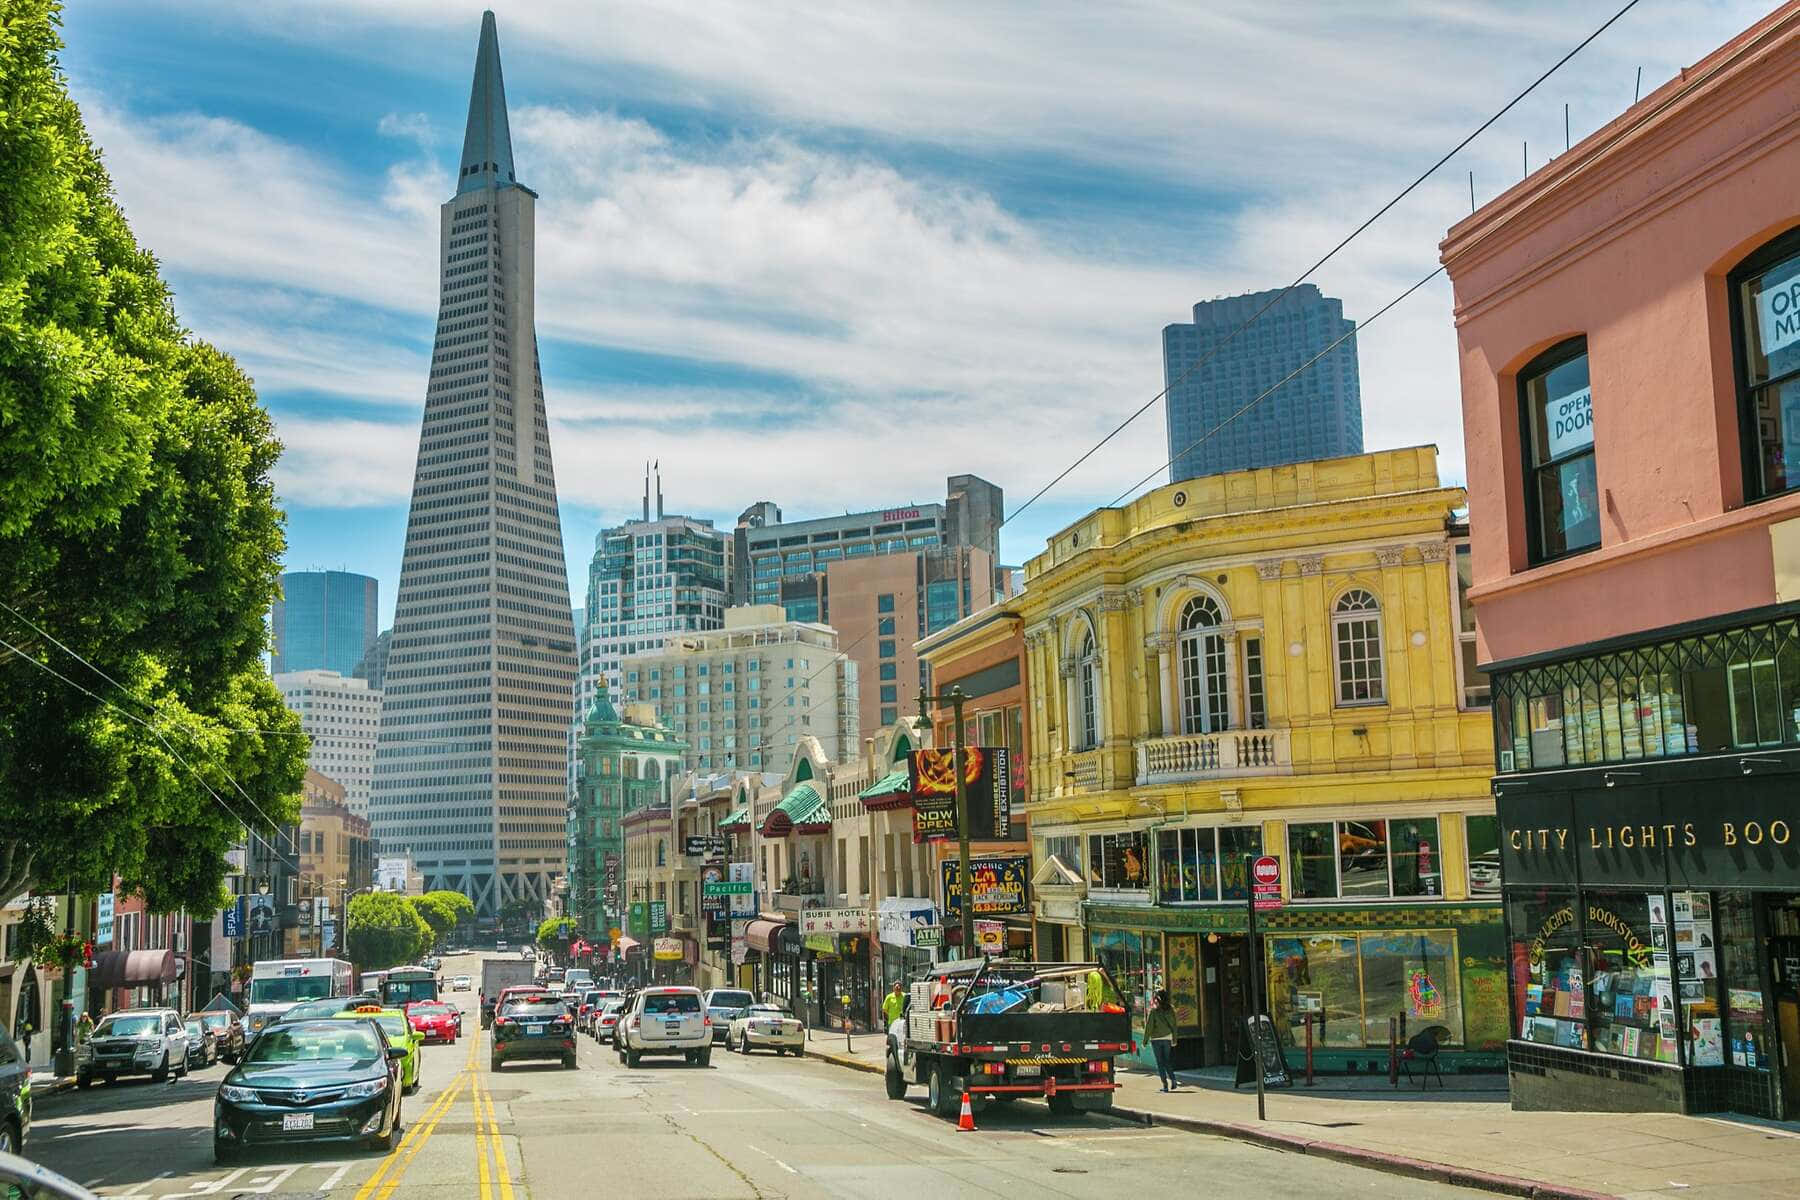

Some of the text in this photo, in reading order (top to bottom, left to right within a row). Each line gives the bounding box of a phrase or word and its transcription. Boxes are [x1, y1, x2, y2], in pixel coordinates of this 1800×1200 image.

[1560, 394, 1591, 416] OPEN
[1556, 408, 1593, 439] DOOR
[883, 509, 920, 521] Hilton
[999, 749, 1007, 812] EXHIBITION
[917, 810, 952, 821] NOW
[918, 819, 953, 830] OPEN
[1511, 820, 1791, 850] CITY LIGHTS BOO
[1004, 869, 1015, 881] &
[709, 884, 748, 893] Pacific
[805, 908, 866, 919] SUSIE HOTEL
[917, 929, 939, 941] ATM
[1541, 906, 1575, 939] LIGHTS
[1589, 905, 1650, 970] BOOKSTORE
